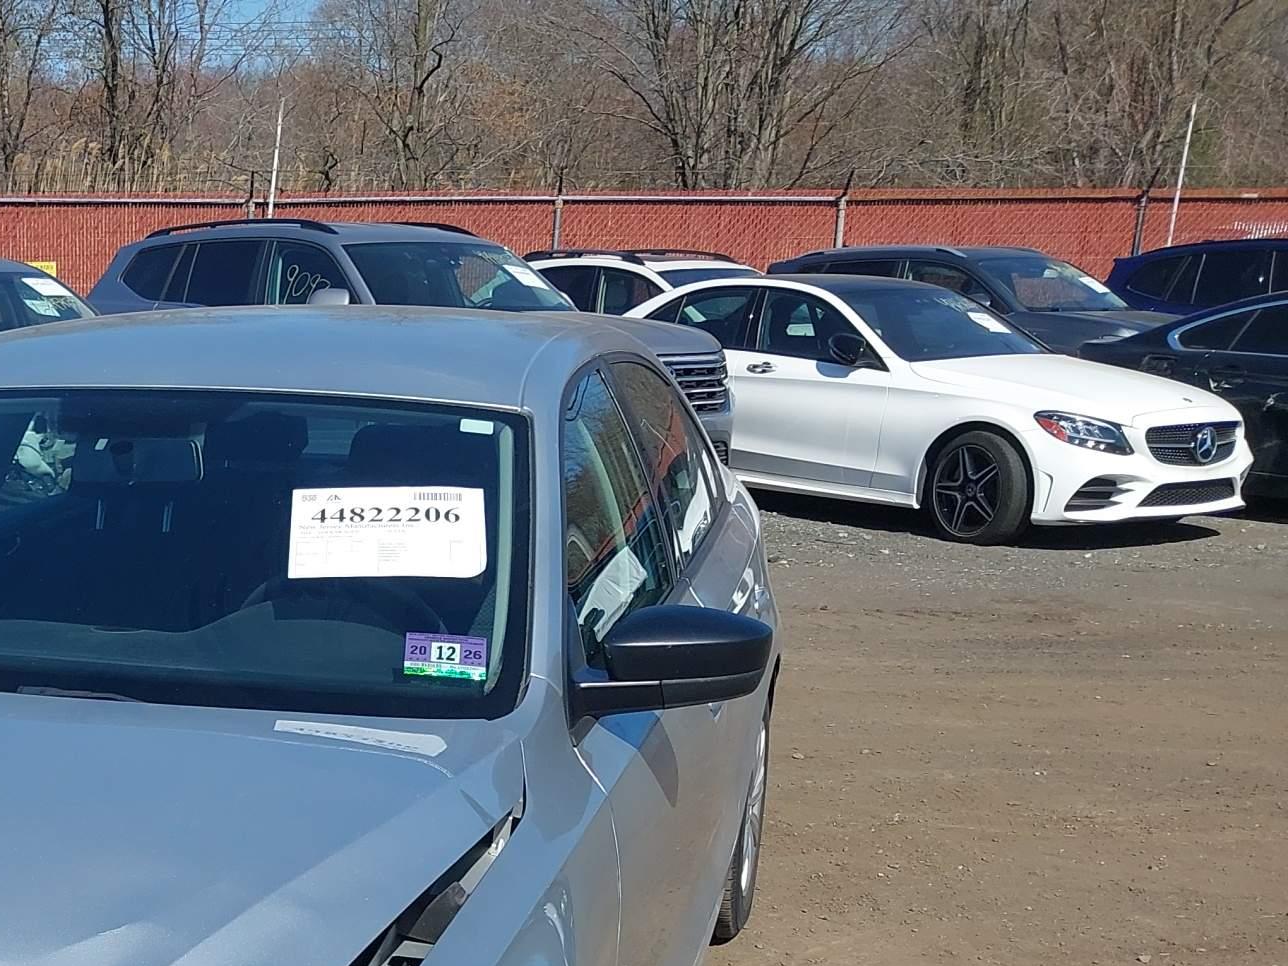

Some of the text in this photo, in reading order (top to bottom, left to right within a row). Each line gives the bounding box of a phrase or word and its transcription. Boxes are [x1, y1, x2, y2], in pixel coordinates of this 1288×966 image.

[311, 506, 461, 523] 44822206
[410, 645, 483, 662] 20 12 26
